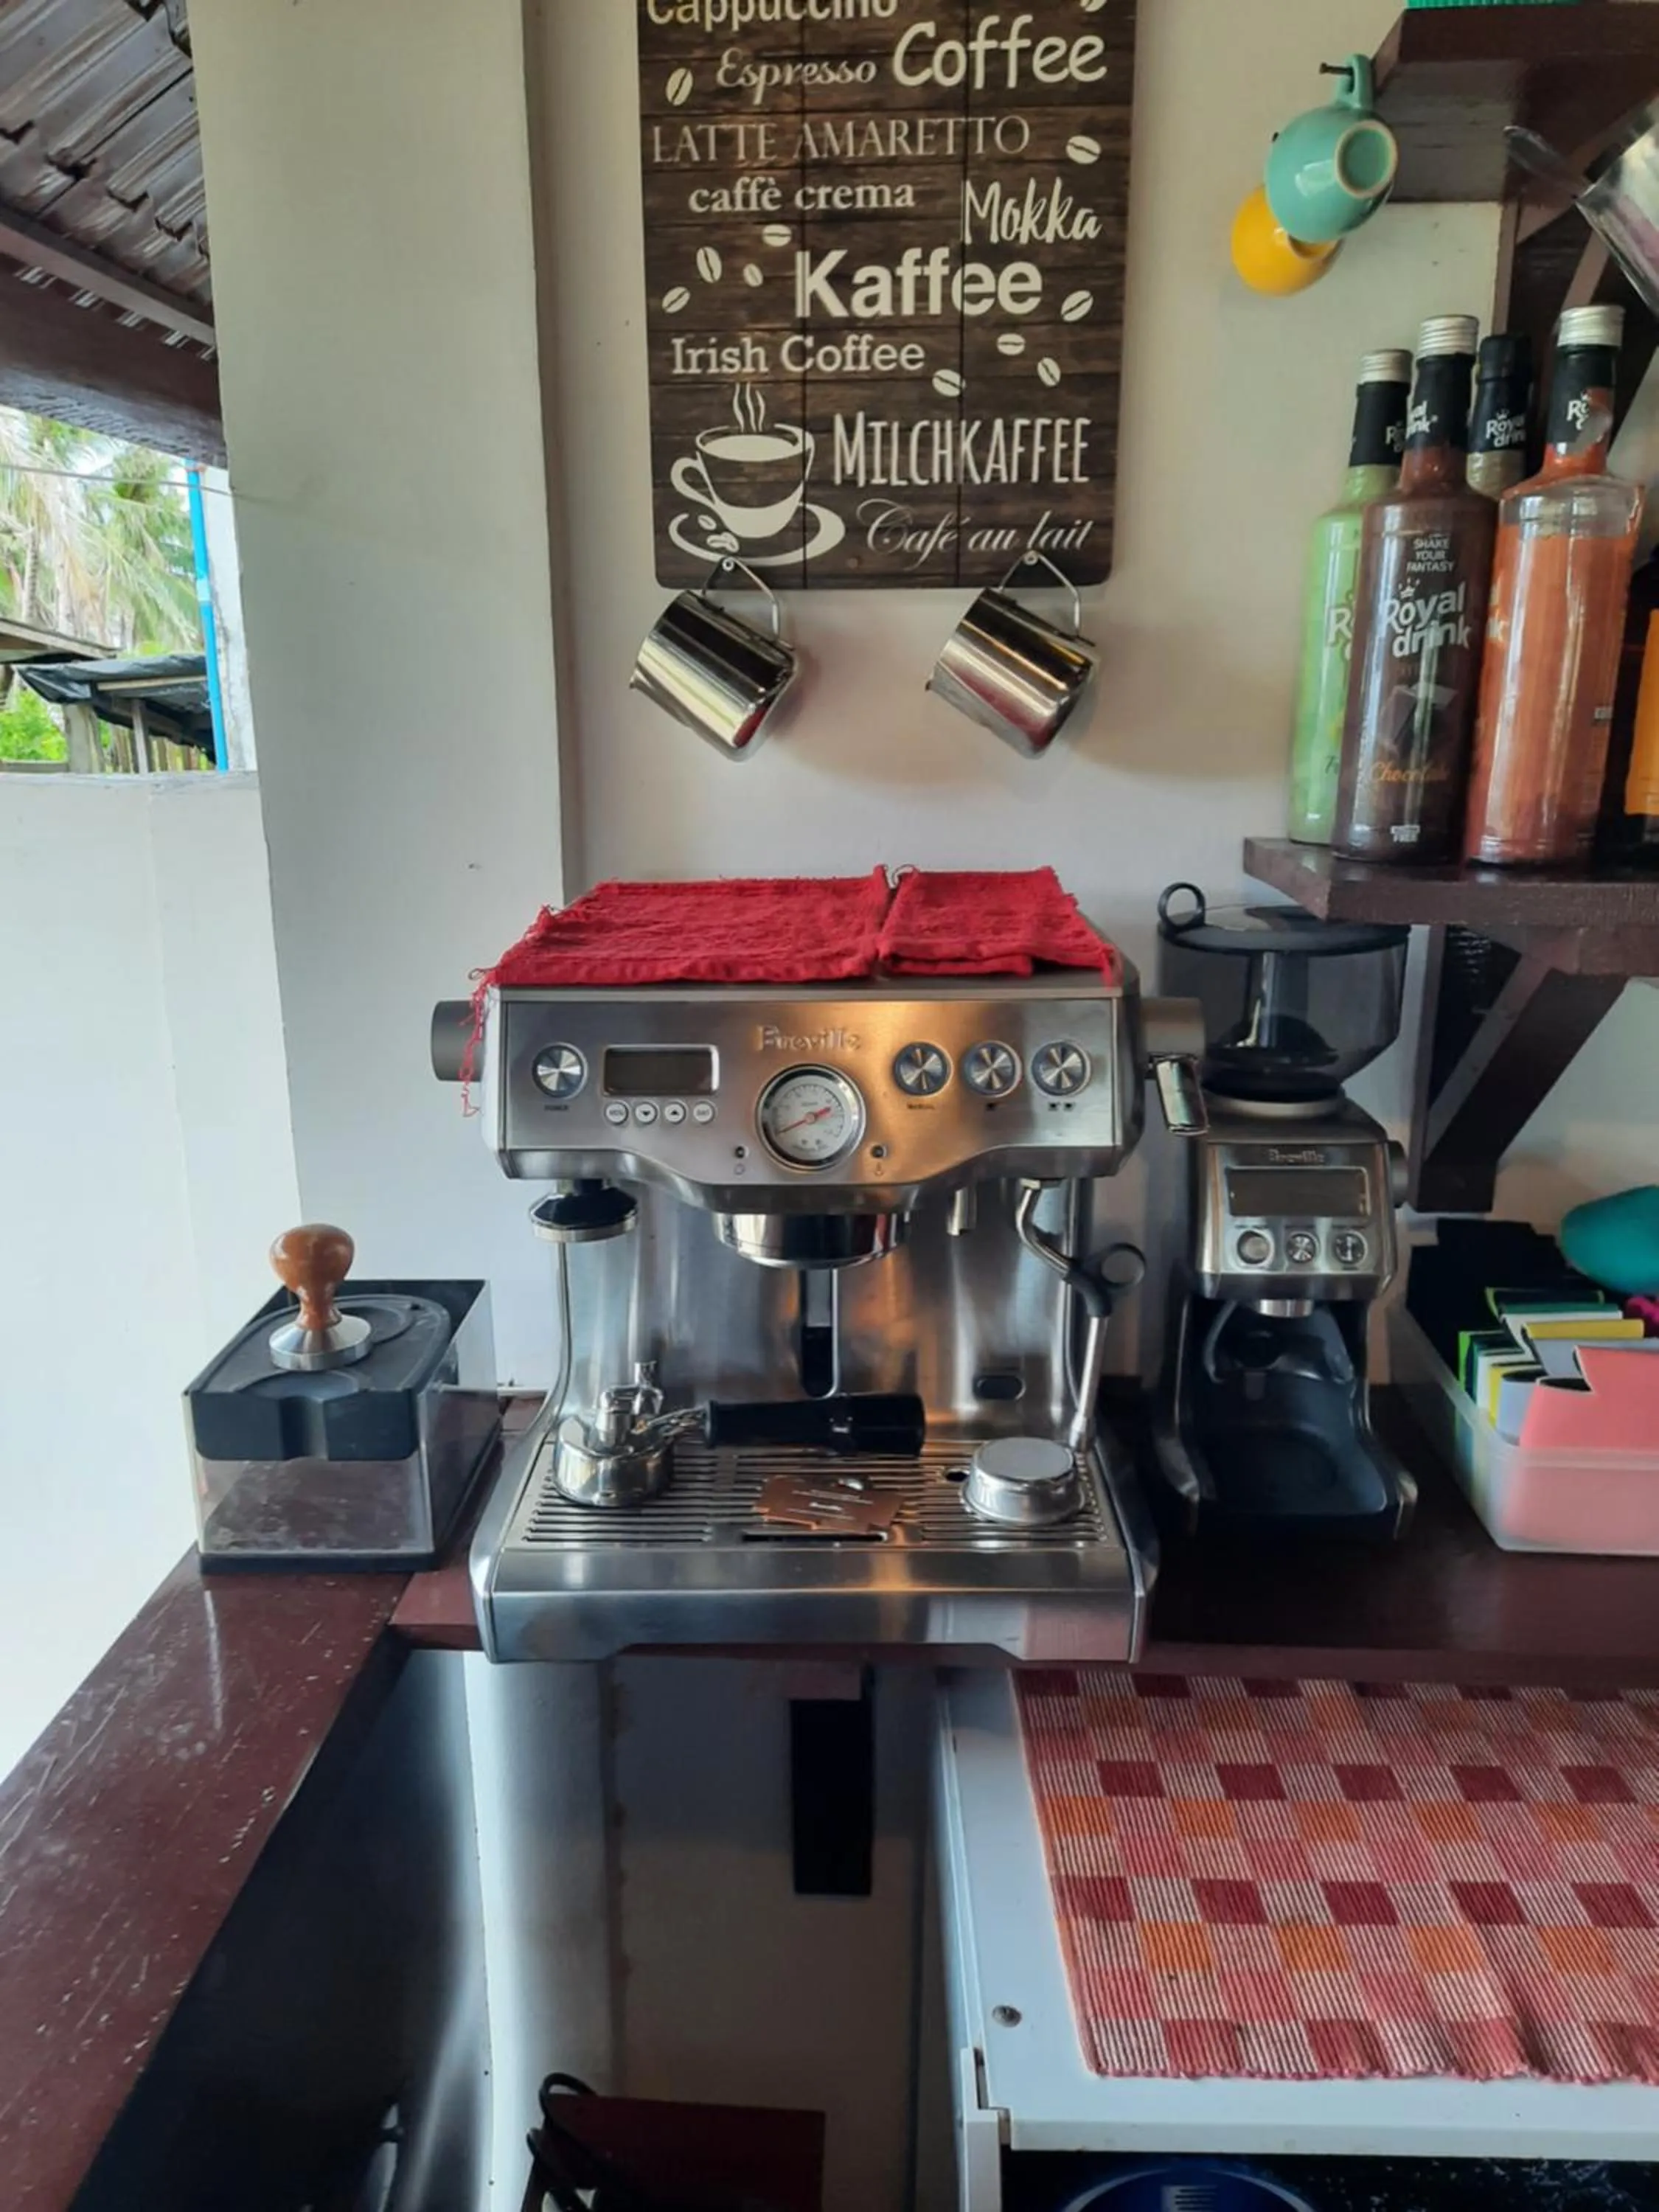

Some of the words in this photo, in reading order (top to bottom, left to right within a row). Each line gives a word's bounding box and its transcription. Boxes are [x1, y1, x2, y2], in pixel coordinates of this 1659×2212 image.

[893, 15, 1107, 88] Coffee
[716, 47, 877, 105] Espresso
[652, 124, 777, 164] LATTE
[793, 116, 1030, 161] AMARETTO
[688, 176, 782, 213] caffè
[795, 182, 915, 210] crema
[961, 176, 1103, 245] Mokka
[795, 246, 1043, 319] Kaffee
[671, 336, 769, 375] Irish
[780, 334, 925, 372] Coffee
[856, 498, 971, 570] Café
[967, 529, 1020, 553] au
[1020, 509, 1096, 552] lait
[1413, 538, 1450, 549] SHAKE
[1415, 550, 1446, 560] YOUR
[1406, 561, 1455, 573] FANTASY
[1385, 580, 1467, 634] Royal
[1392, 613, 1471, 658] drink
